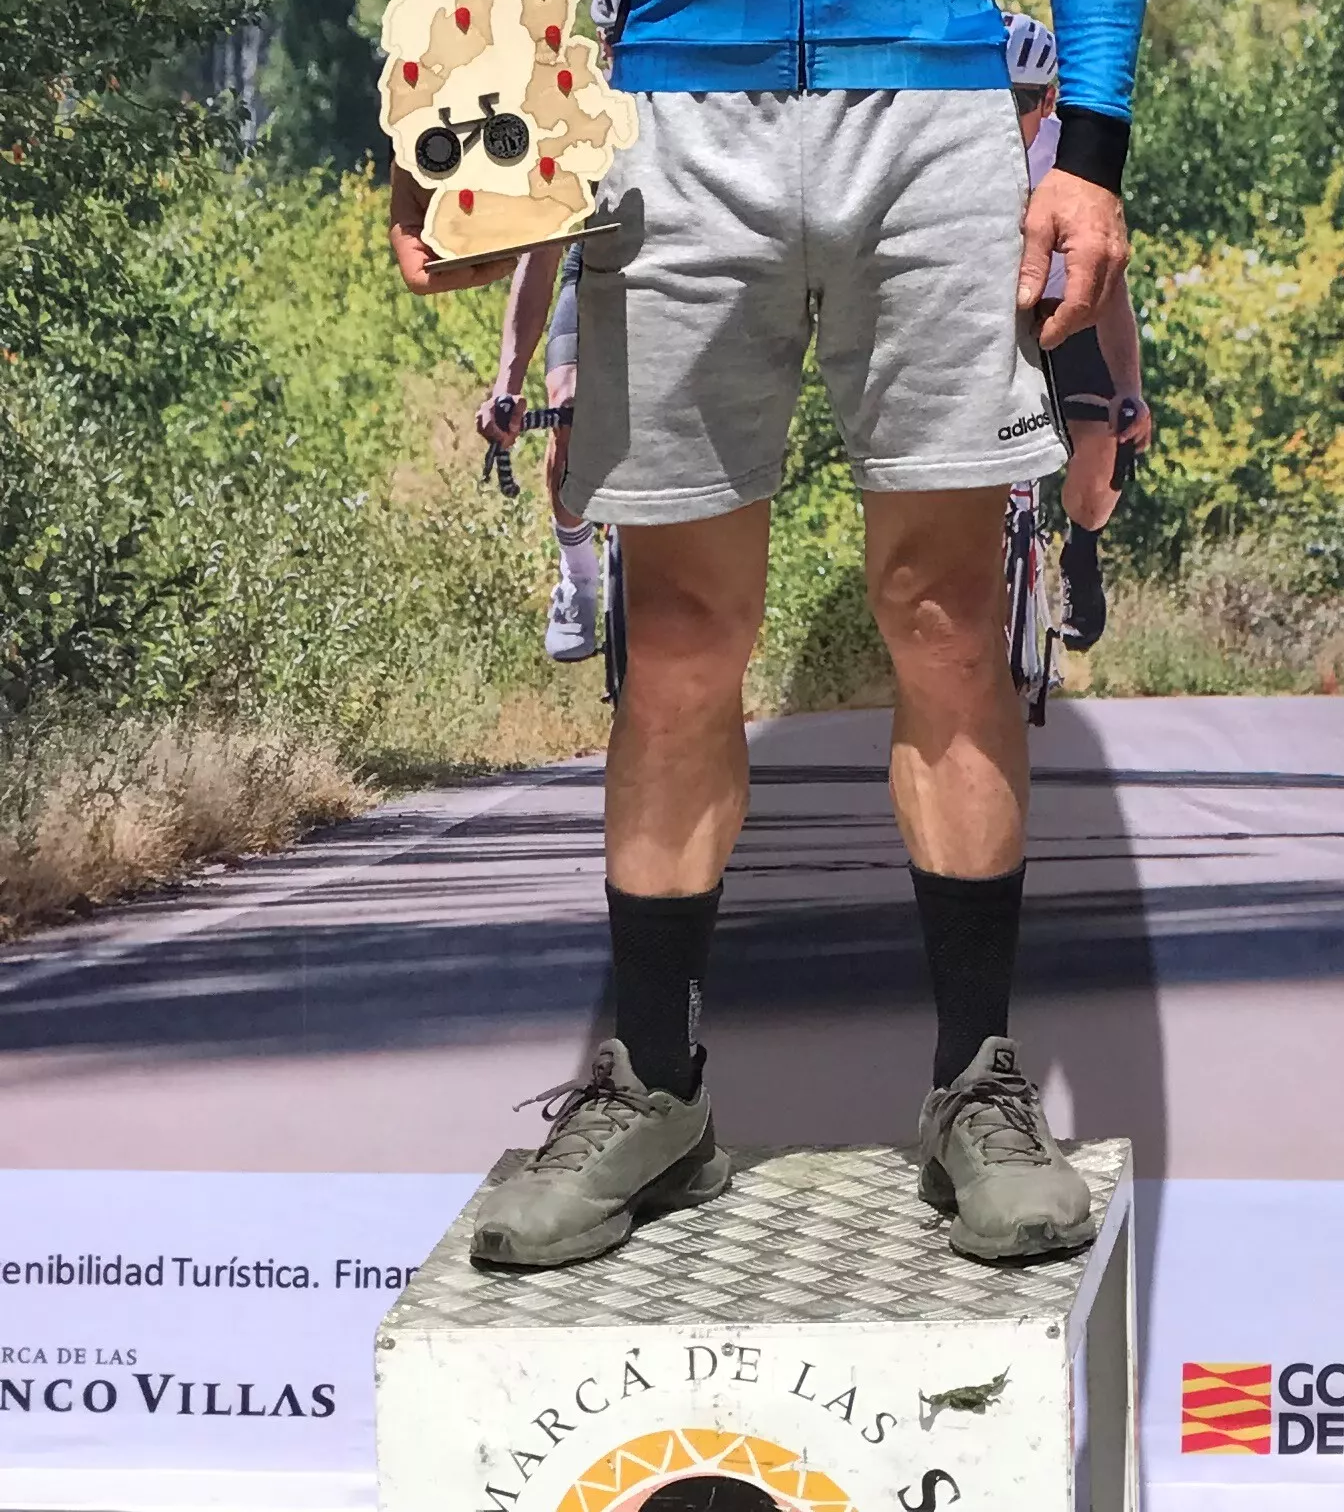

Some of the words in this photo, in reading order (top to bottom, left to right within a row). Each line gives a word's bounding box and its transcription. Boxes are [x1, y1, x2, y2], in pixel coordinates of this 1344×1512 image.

[171, 1256, 320, 1290] Turística.
[57, 1348, 88, 1366] DE
[95, 1348, 138, 1366] LAS
[685, 1345, 763, 1385] DE
[789, 1360, 898, 1446] LAS
[1278, 1412, 1344, 1455] DE
